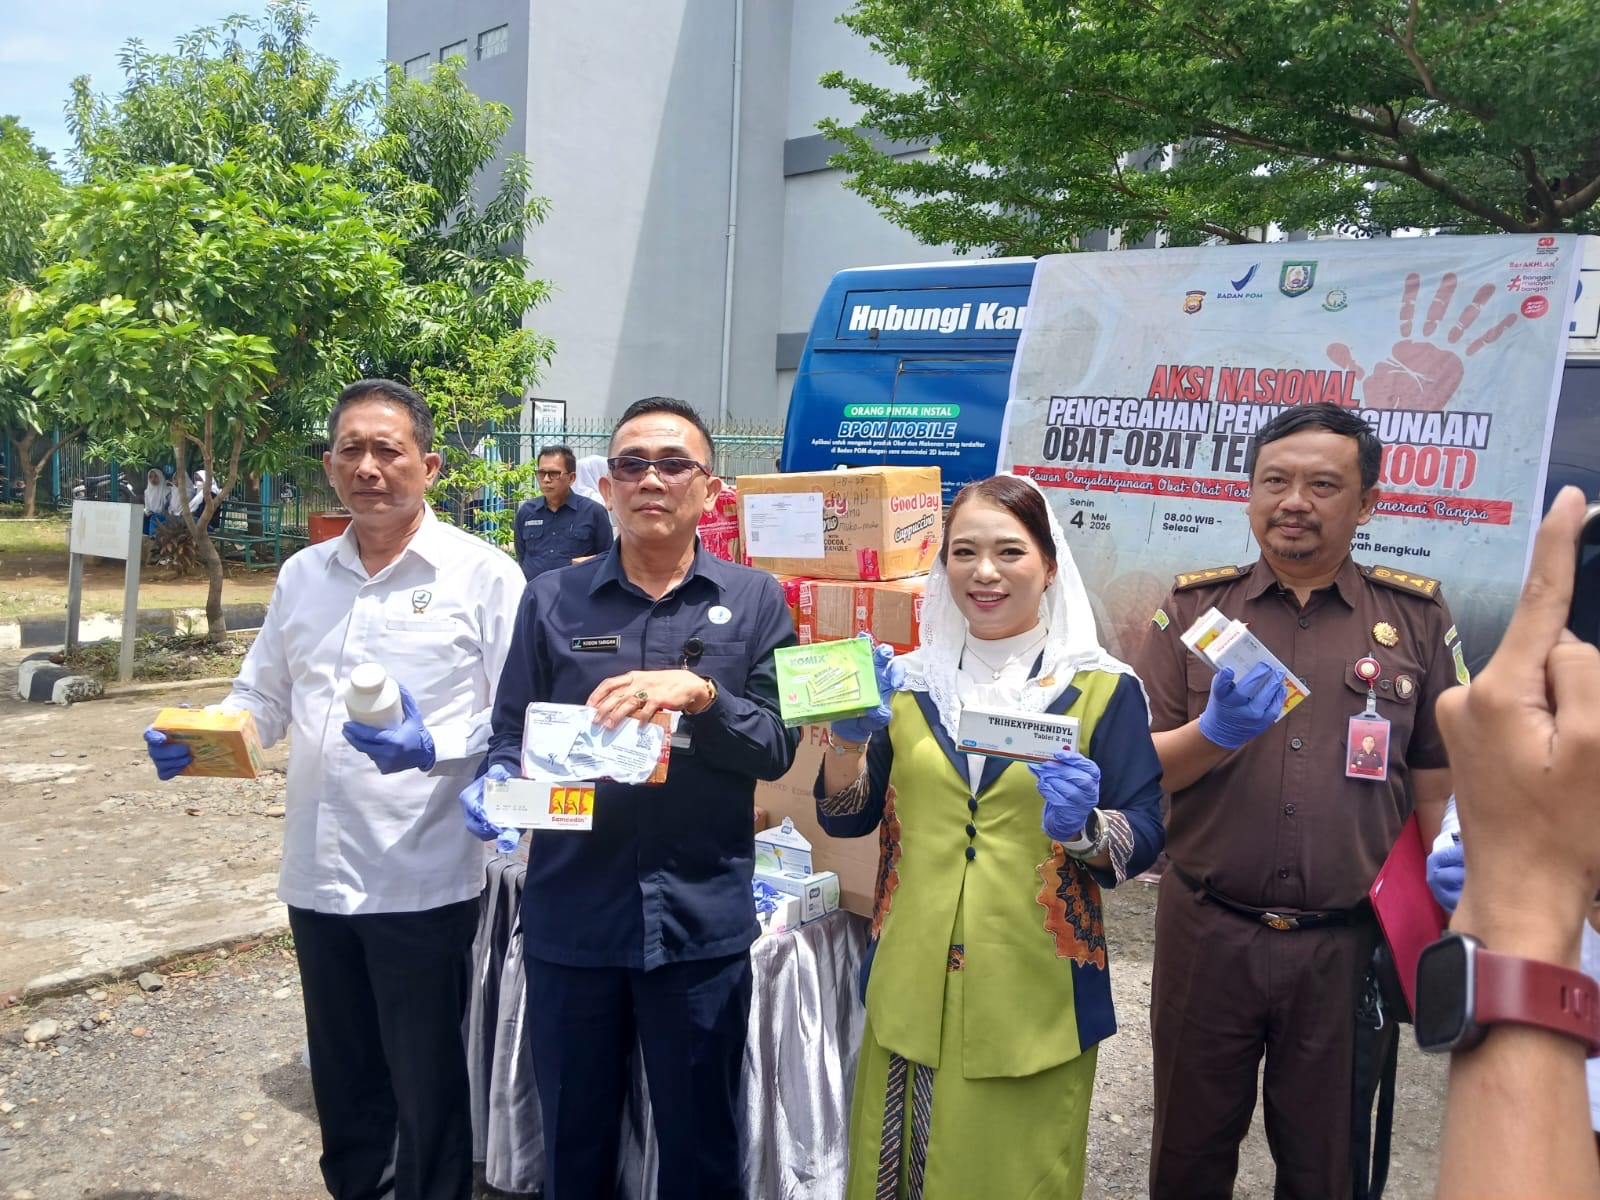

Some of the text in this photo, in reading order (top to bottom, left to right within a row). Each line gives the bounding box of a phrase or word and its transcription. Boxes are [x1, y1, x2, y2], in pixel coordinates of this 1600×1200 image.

[849, 303, 972, 333] Hubungi
[1148, 364, 1360, 408] AKSI NASIONAL
[851, 407, 952, 416] ORANG PINTAR INSTAL
[1048, 396, 1212, 434] PENCEGAHAN
[838, 421, 957, 439] BPOM MOBILE
[1043, 426, 1200, 469] OBAT-OBAT
[1379, 444, 1477, 490] (OOT)
[1065, 471, 1154, 494] Penyalahgunaan
[1158, 478, 1221, 496] Obat-Obat
[891, 493, 939, 512] Good Day
[1069, 498, 1095, 507] Senin
[1070, 510, 1084, 529] 4
[1091, 513, 1107, 521] Mei
[1164, 513, 1192, 524] 08.00
[1195, 515, 1215, 525] WIB
[1433, 501, 1489, 524] Bangsa
[894, 514, 934, 543] Cappuccino
[1090, 522, 1111, 530] 2026
[1162, 522, 1199, 533] Selesai
[1374, 543, 1431, 557] Bengkulu
[790, 655, 826, 667] KOMIX
[988, 716, 1073, 736] TRIHEXYPHENIDYL
[1033, 732, 1054, 741] Tablet
